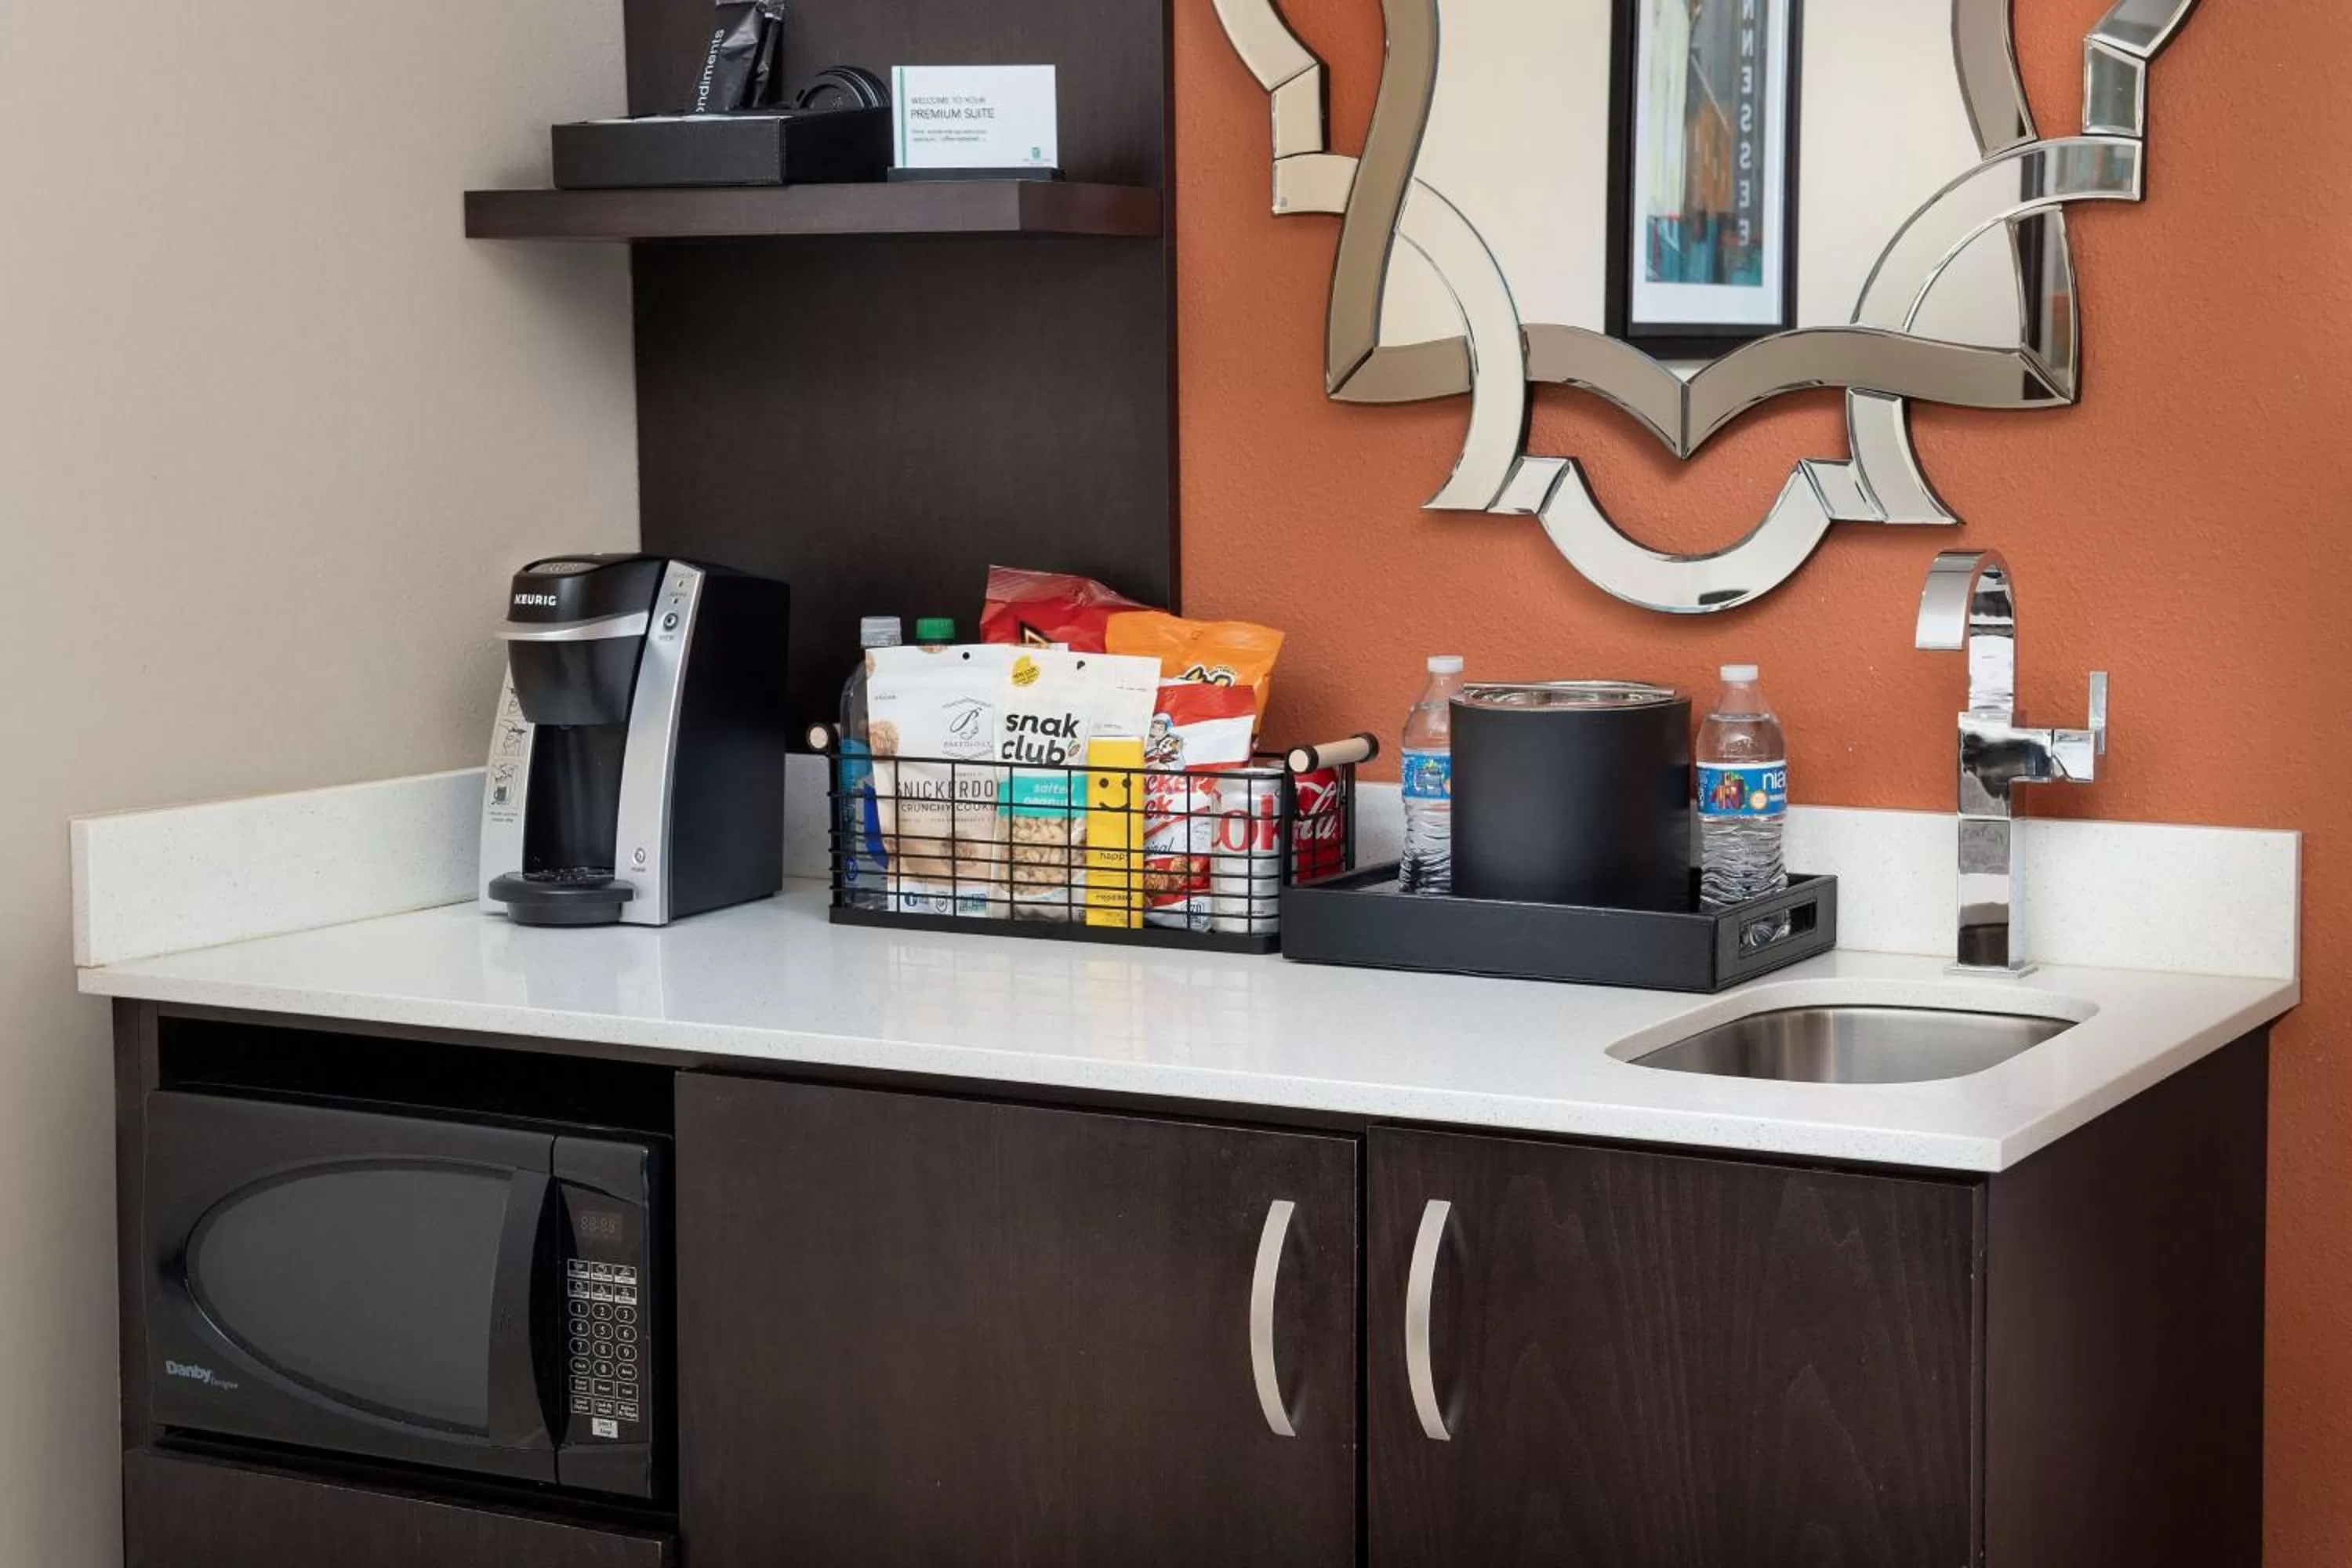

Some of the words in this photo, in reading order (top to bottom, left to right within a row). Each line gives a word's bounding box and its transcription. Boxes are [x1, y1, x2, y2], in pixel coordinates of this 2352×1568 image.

[910, 108, 961, 119] PREMIUM
[964, 107, 995, 118] SUITE
[514, 593, 557, 606] KEURIG
[1006, 713, 1080, 738] snak
[1001, 735, 1066, 765] club
[165, 1360, 213, 1383] Danby
